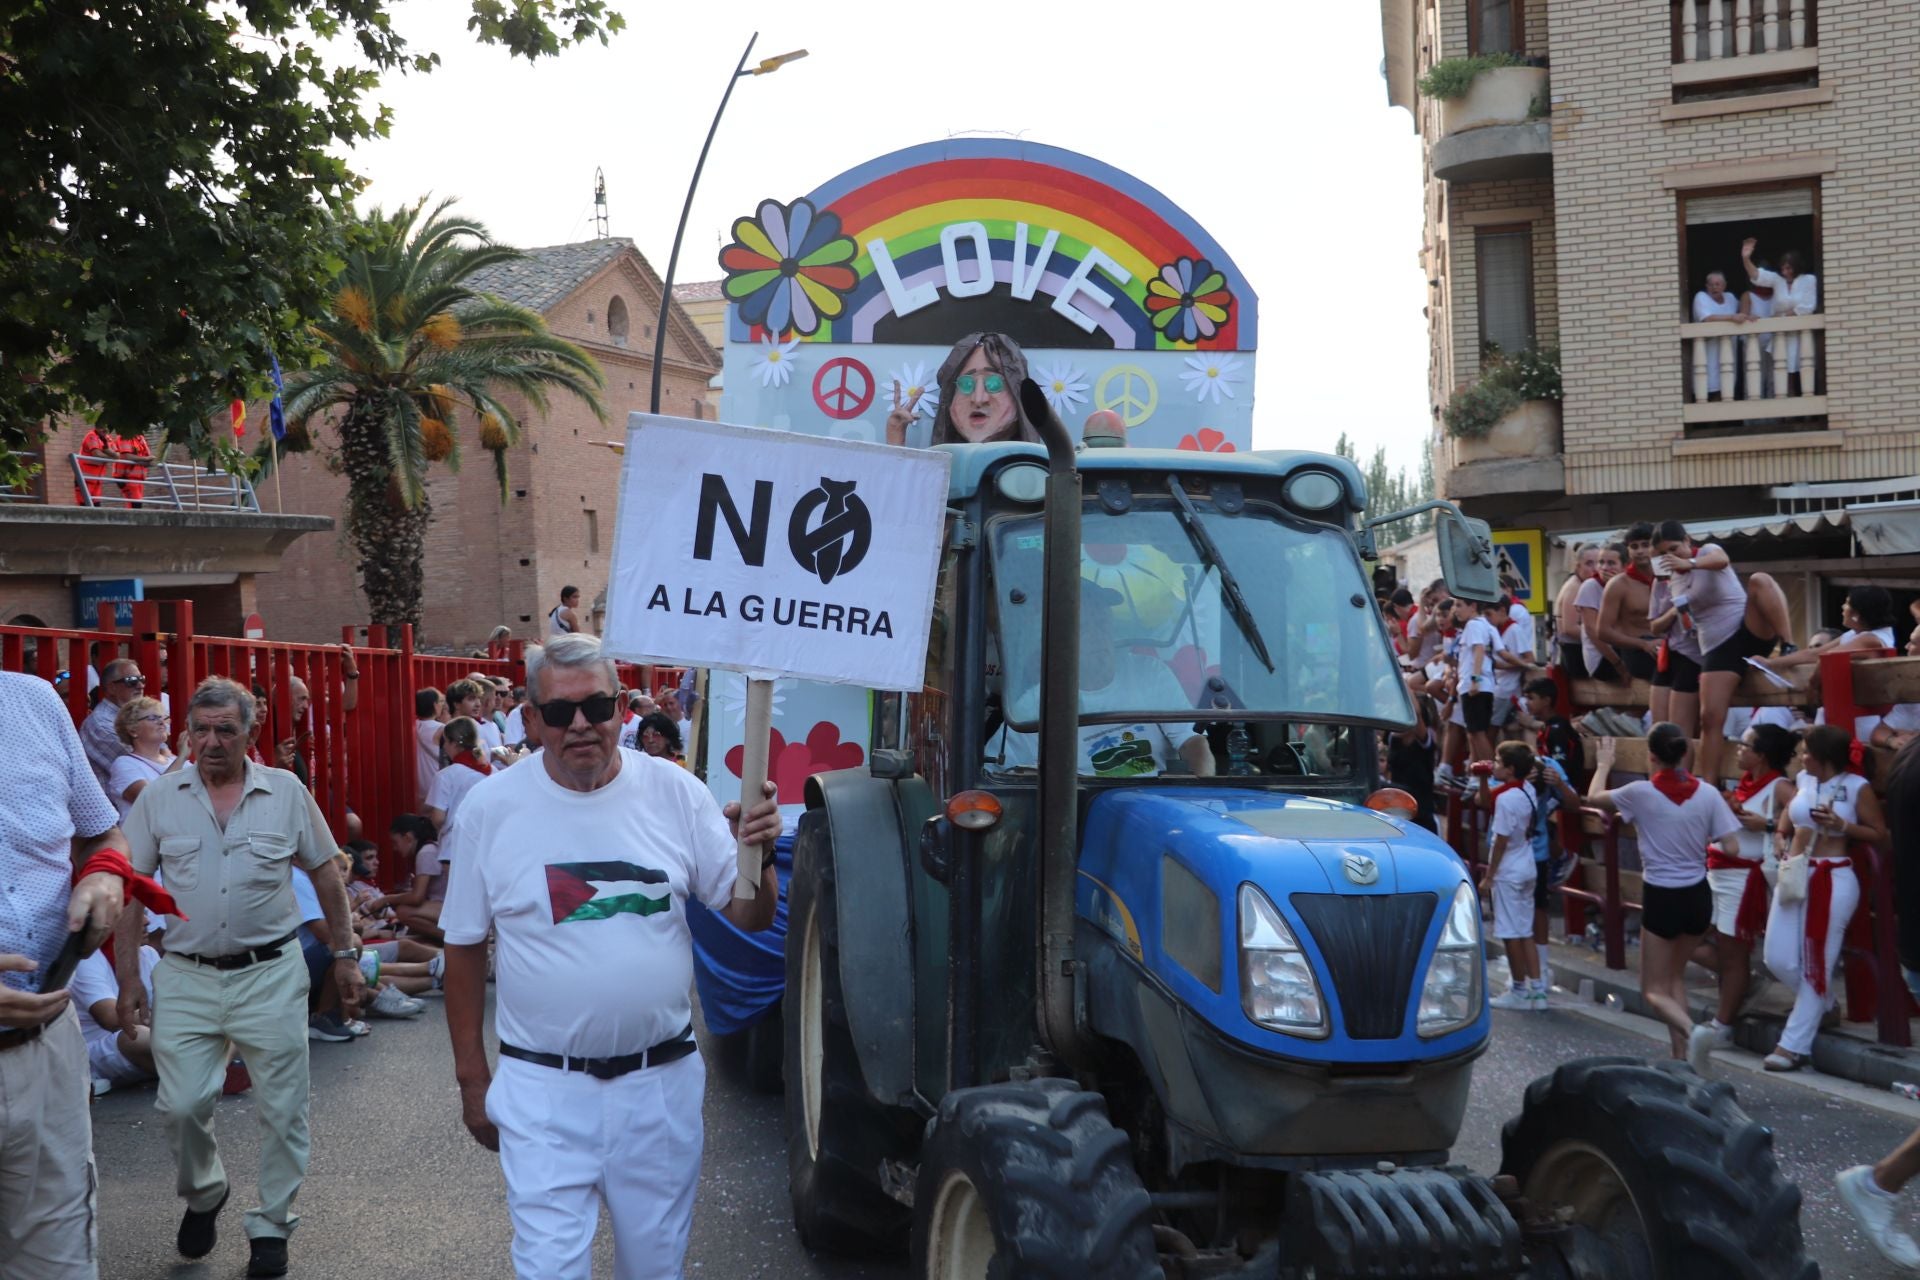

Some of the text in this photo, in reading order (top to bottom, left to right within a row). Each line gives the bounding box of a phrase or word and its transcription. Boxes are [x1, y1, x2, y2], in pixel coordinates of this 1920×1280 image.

[866, 221, 1132, 334] LOVE
[692, 472, 873, 585] NO
[82, 595, 135, 619] URGCIAS
[647, 584, 894, 639] A LA GUERRA
